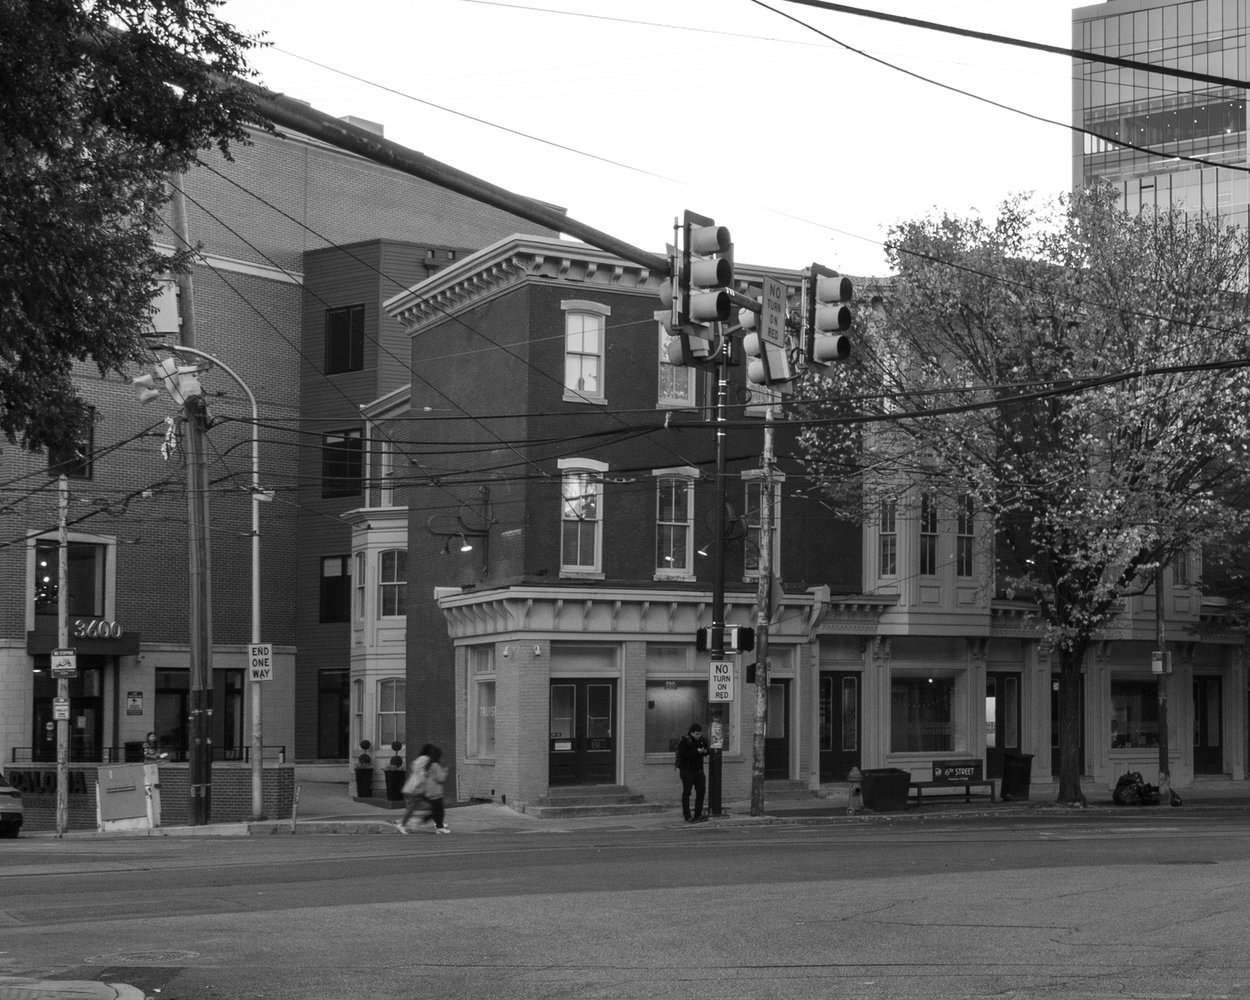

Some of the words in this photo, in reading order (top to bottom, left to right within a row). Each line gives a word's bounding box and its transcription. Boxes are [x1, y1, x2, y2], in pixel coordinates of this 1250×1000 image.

[770, 284, 781, 299] NO
[767, 298, 781, 313] TURN
[769, 314, 779, 326] ON
[767, 327, 779, 340] RED
[74, 619, 123, 639] 3600
[252, 647, 270, 656] END
[252, 658, 270, 667] ONE
[252, 669, 270, 679] WAY
[715, 664, 729, 674] NO
[955, 767, 975, 776] STREET
[9, 771, 87, 794] PALOA
